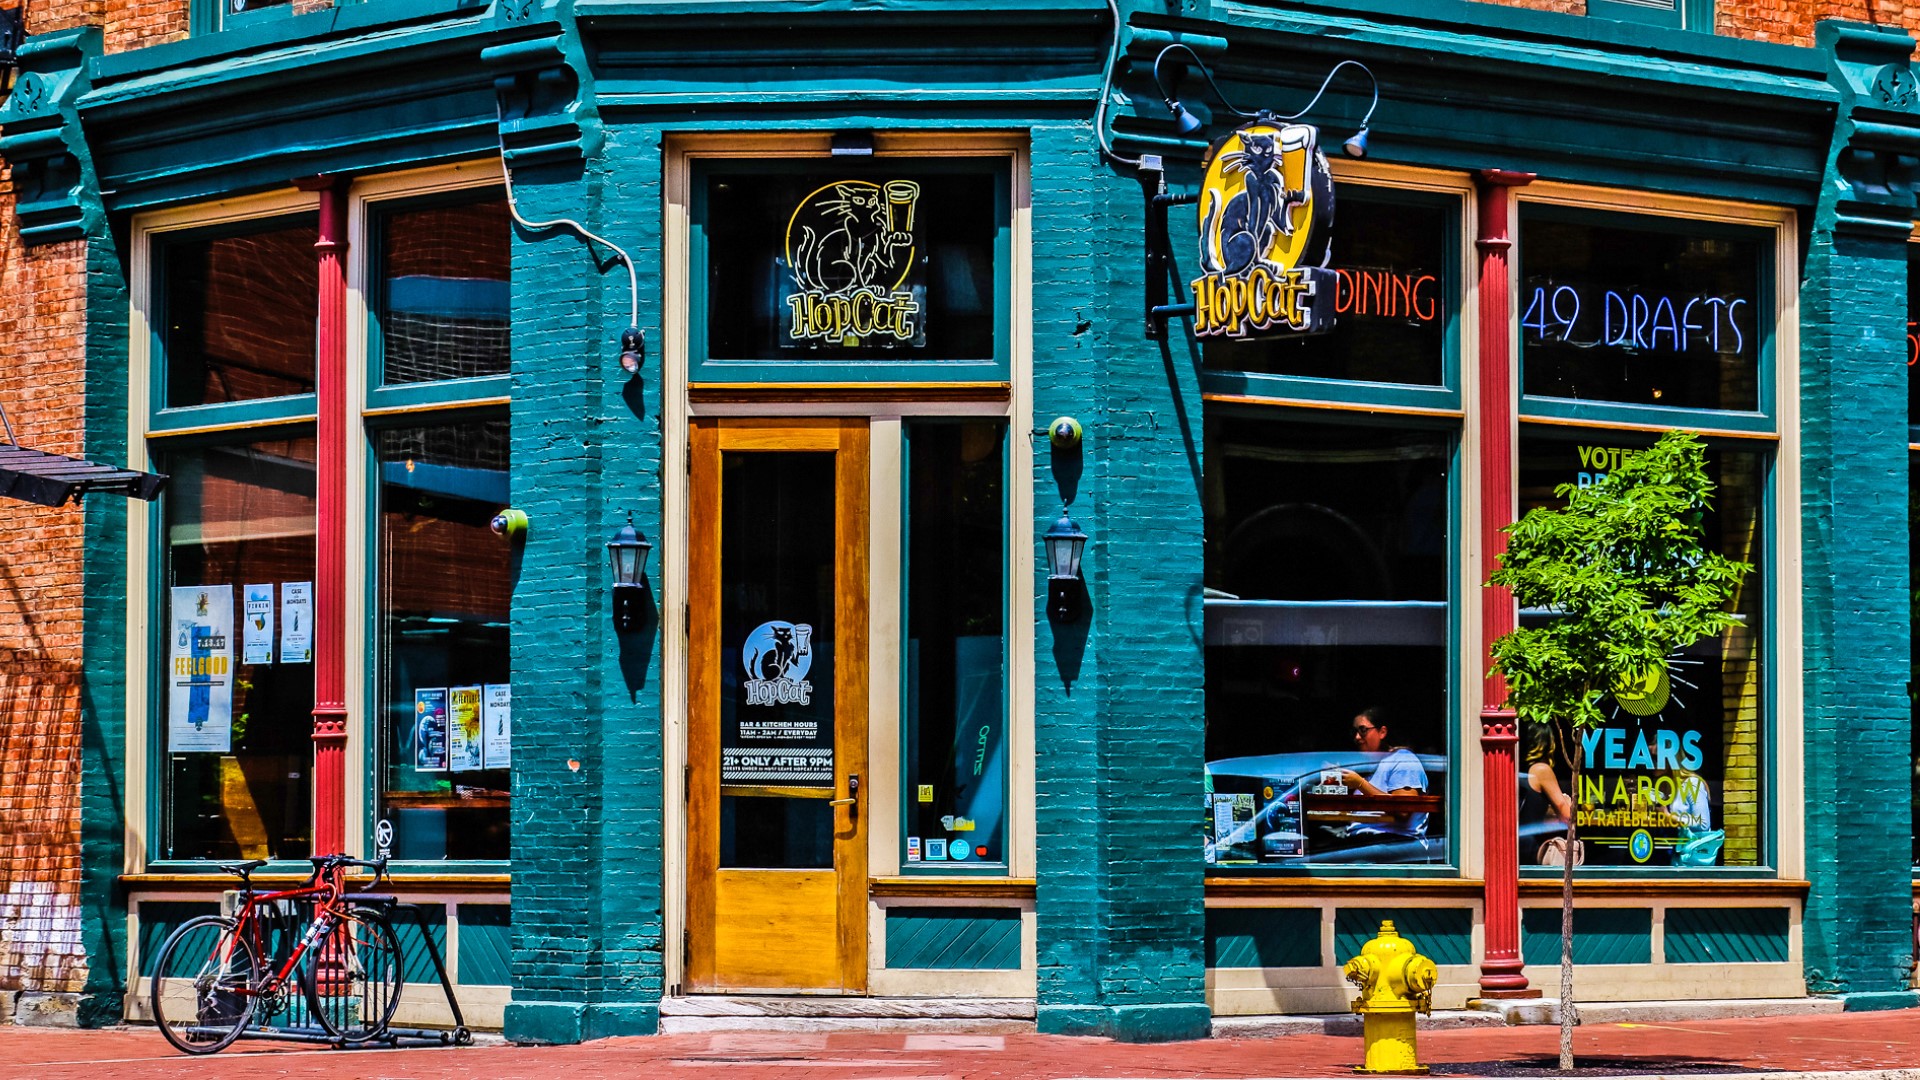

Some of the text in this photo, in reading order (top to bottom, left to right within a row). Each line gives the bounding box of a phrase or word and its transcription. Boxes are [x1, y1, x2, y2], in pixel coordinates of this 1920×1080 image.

[1190, 266, 1311, 335] HopCat
[1335, 268, 1436, 321] DINING
[788, 290, 917, 341] HopCat
[1522, 286, 1747, 354] 49 DRAFTS
[175, 656, 228, 676] FEELGOOD
[744, 678, 813, 706] HopCat
[723, 756, 833, 767] 21+ ONLY AFTER 9PM
[1576, 728, 1704, 770] YEARS
[1578, 775, 1703, 807] IN A ROW
[1577, 811, 1702, 828] BY RATEBEER.COM
